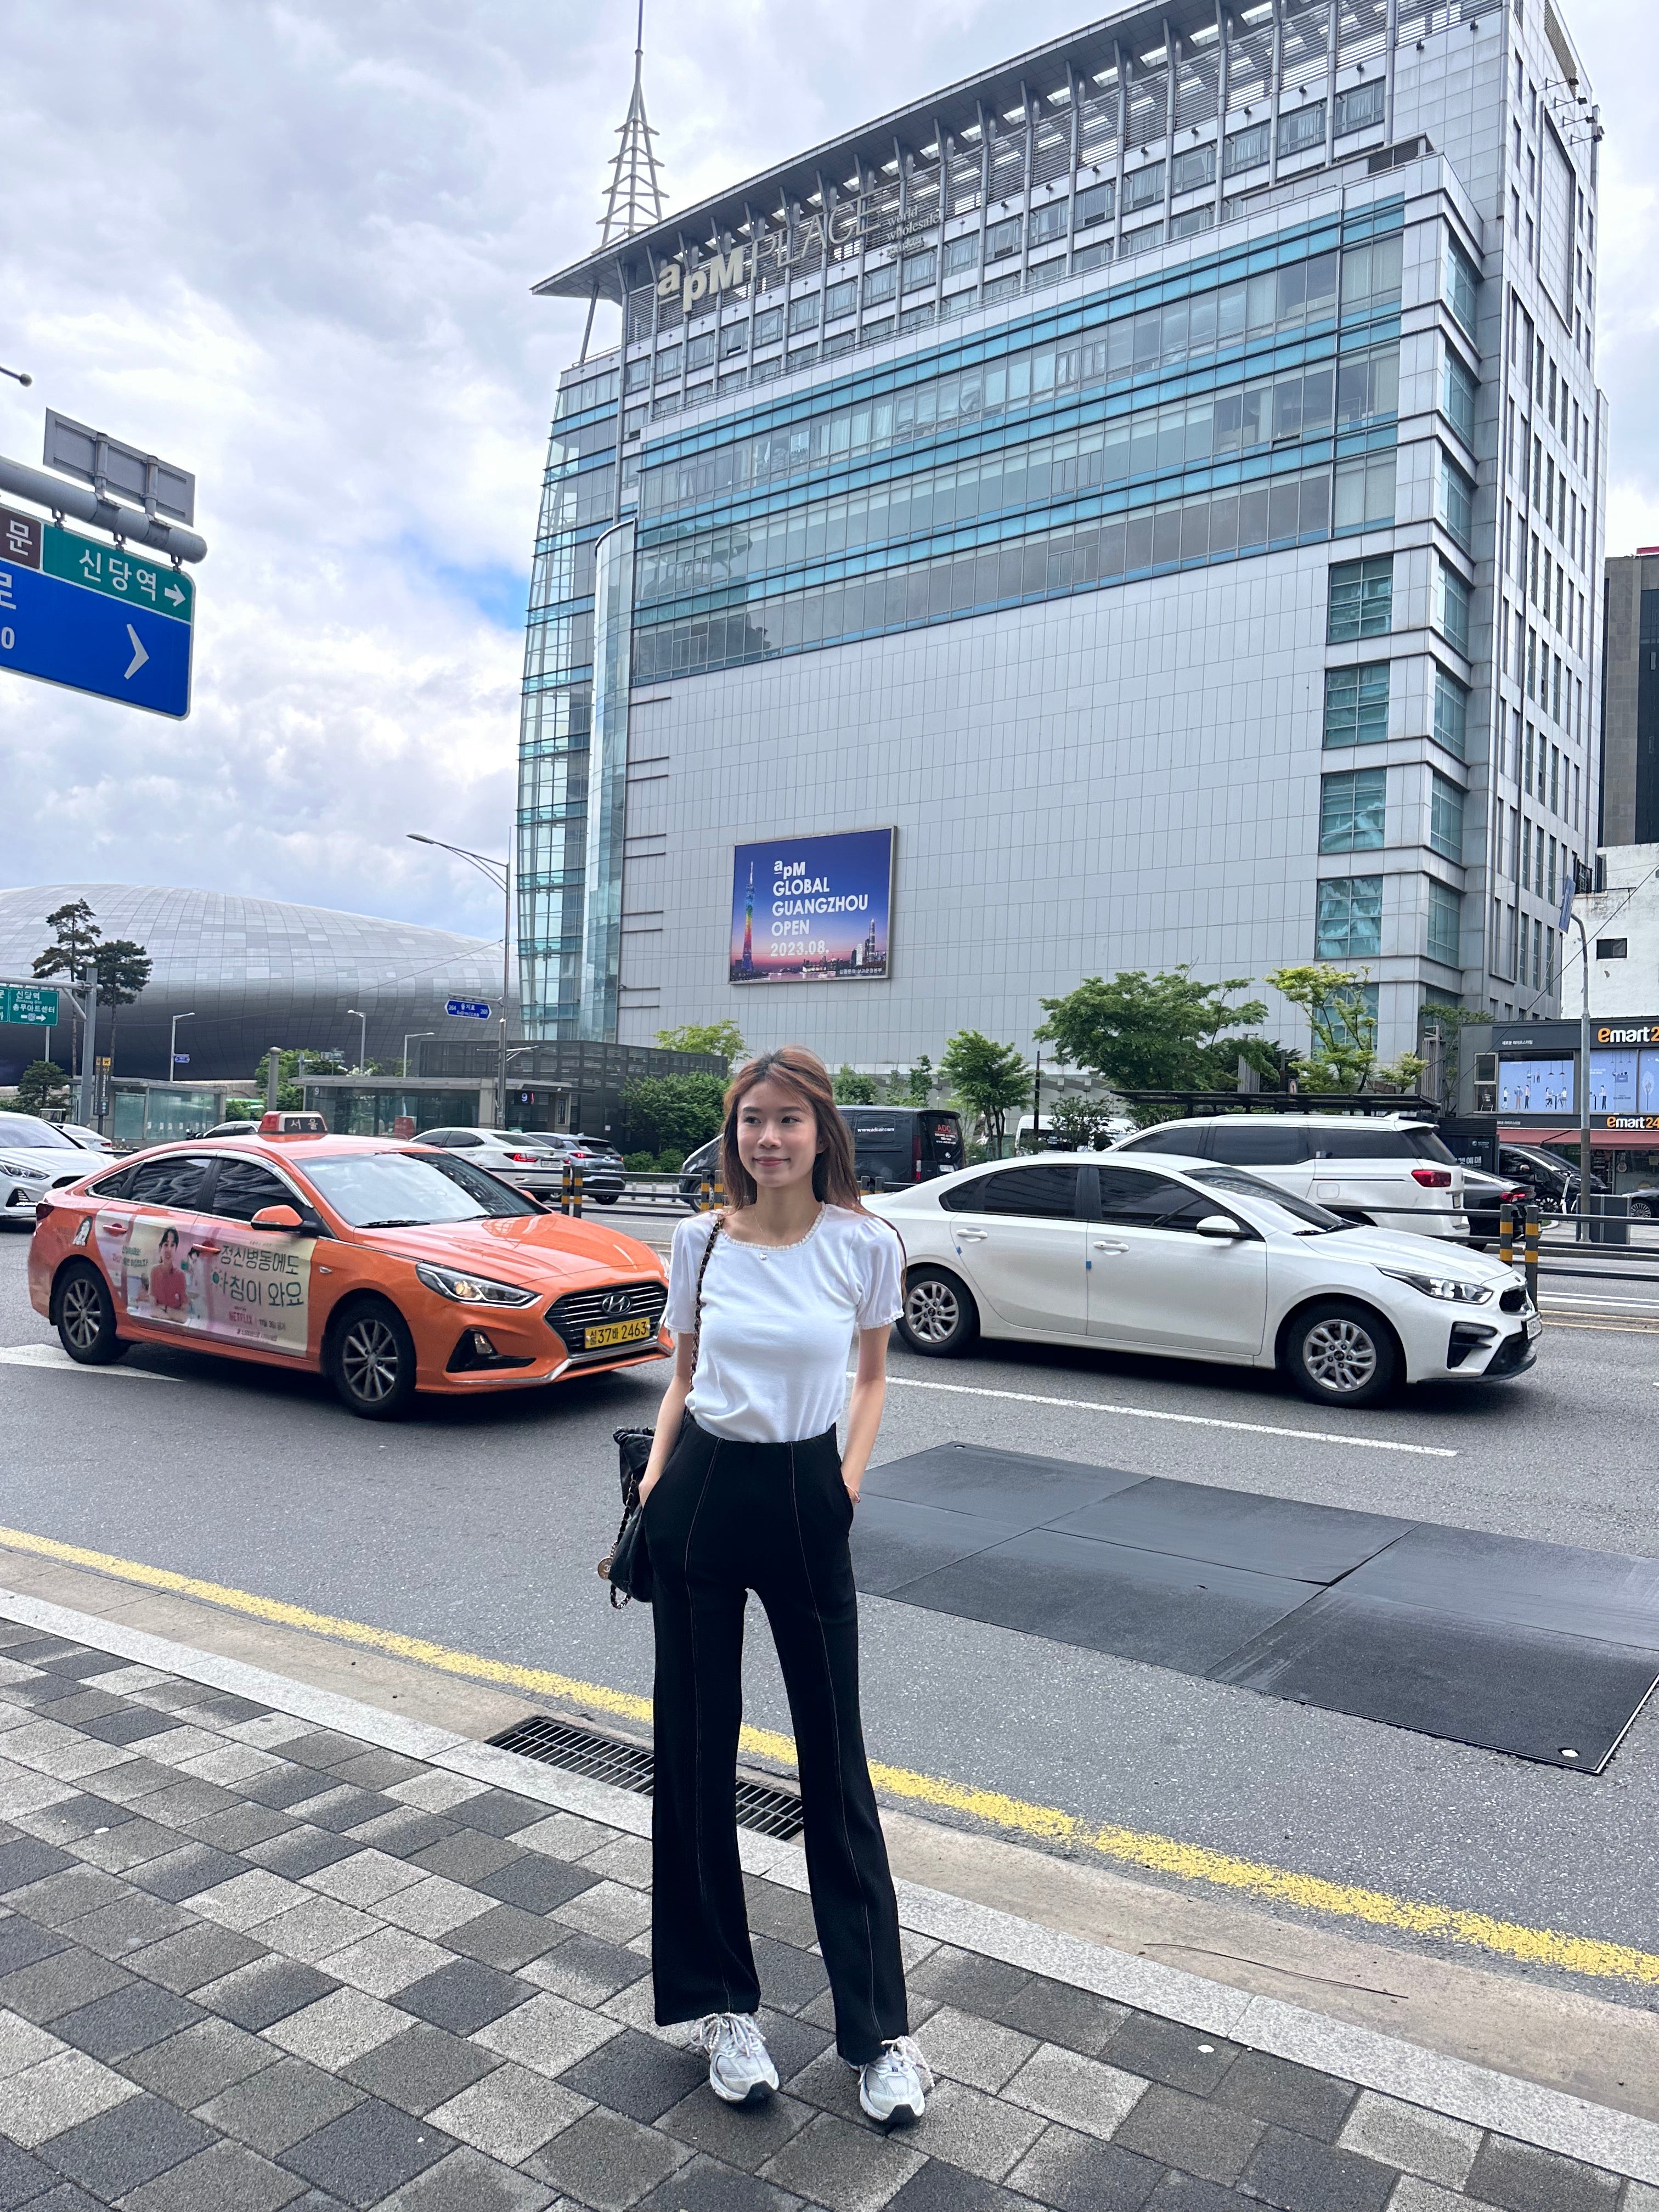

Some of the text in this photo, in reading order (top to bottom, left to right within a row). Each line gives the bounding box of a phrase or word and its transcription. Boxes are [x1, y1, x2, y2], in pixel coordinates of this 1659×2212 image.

[657, 245, 744, 313] apM
[6, 520, 33, 556] 문
[79, 549, 157, 602] 신당역
[774, 860, 806, 879] apM
[773, 877, 830, 896] GLOBAL
[772, 894, 868, 917] GUANGZHOU
[771, 919, 810, 937] OPEN
[771, 940, 830, 957] 2023.08.
[16, 990, 40, 1001] 신당역
[314, 1087, 320, 1096] 9
[521, 1093, 528, 1102] 9
[221, 1245, 299, 1275] 정신병동에도
[268, 1281, 304, 1307] 와요
[229, 1311, 252, 1324] NETFLIX
[597, 1328, 619, 1344] 37바
[621, 1321, 647, 1339] 2463
